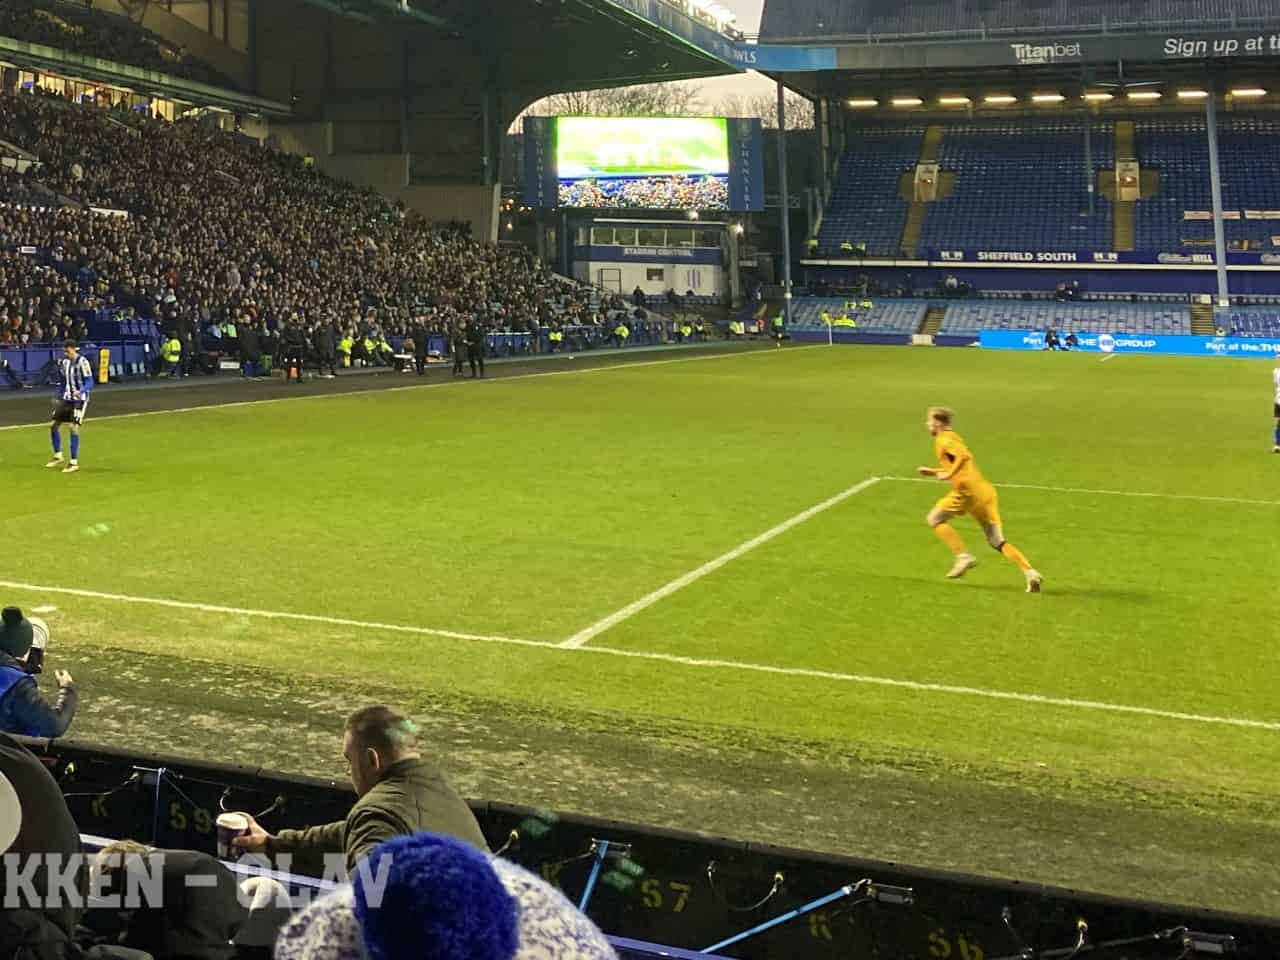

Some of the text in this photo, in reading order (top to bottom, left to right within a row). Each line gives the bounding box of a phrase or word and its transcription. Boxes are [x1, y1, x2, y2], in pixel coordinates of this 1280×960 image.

[1163, 38, 1207, 57] Sign
[1213, 38, 1239, 56] up
[1245, 36, 1264, 51] at
[977, 251, 1077, 262] SHEFFIELD SOUTH
[1115, 340, 1157, 348] GROUP
[169, 801, 211, 833] 59
[641, 879, 690, 913] 57
